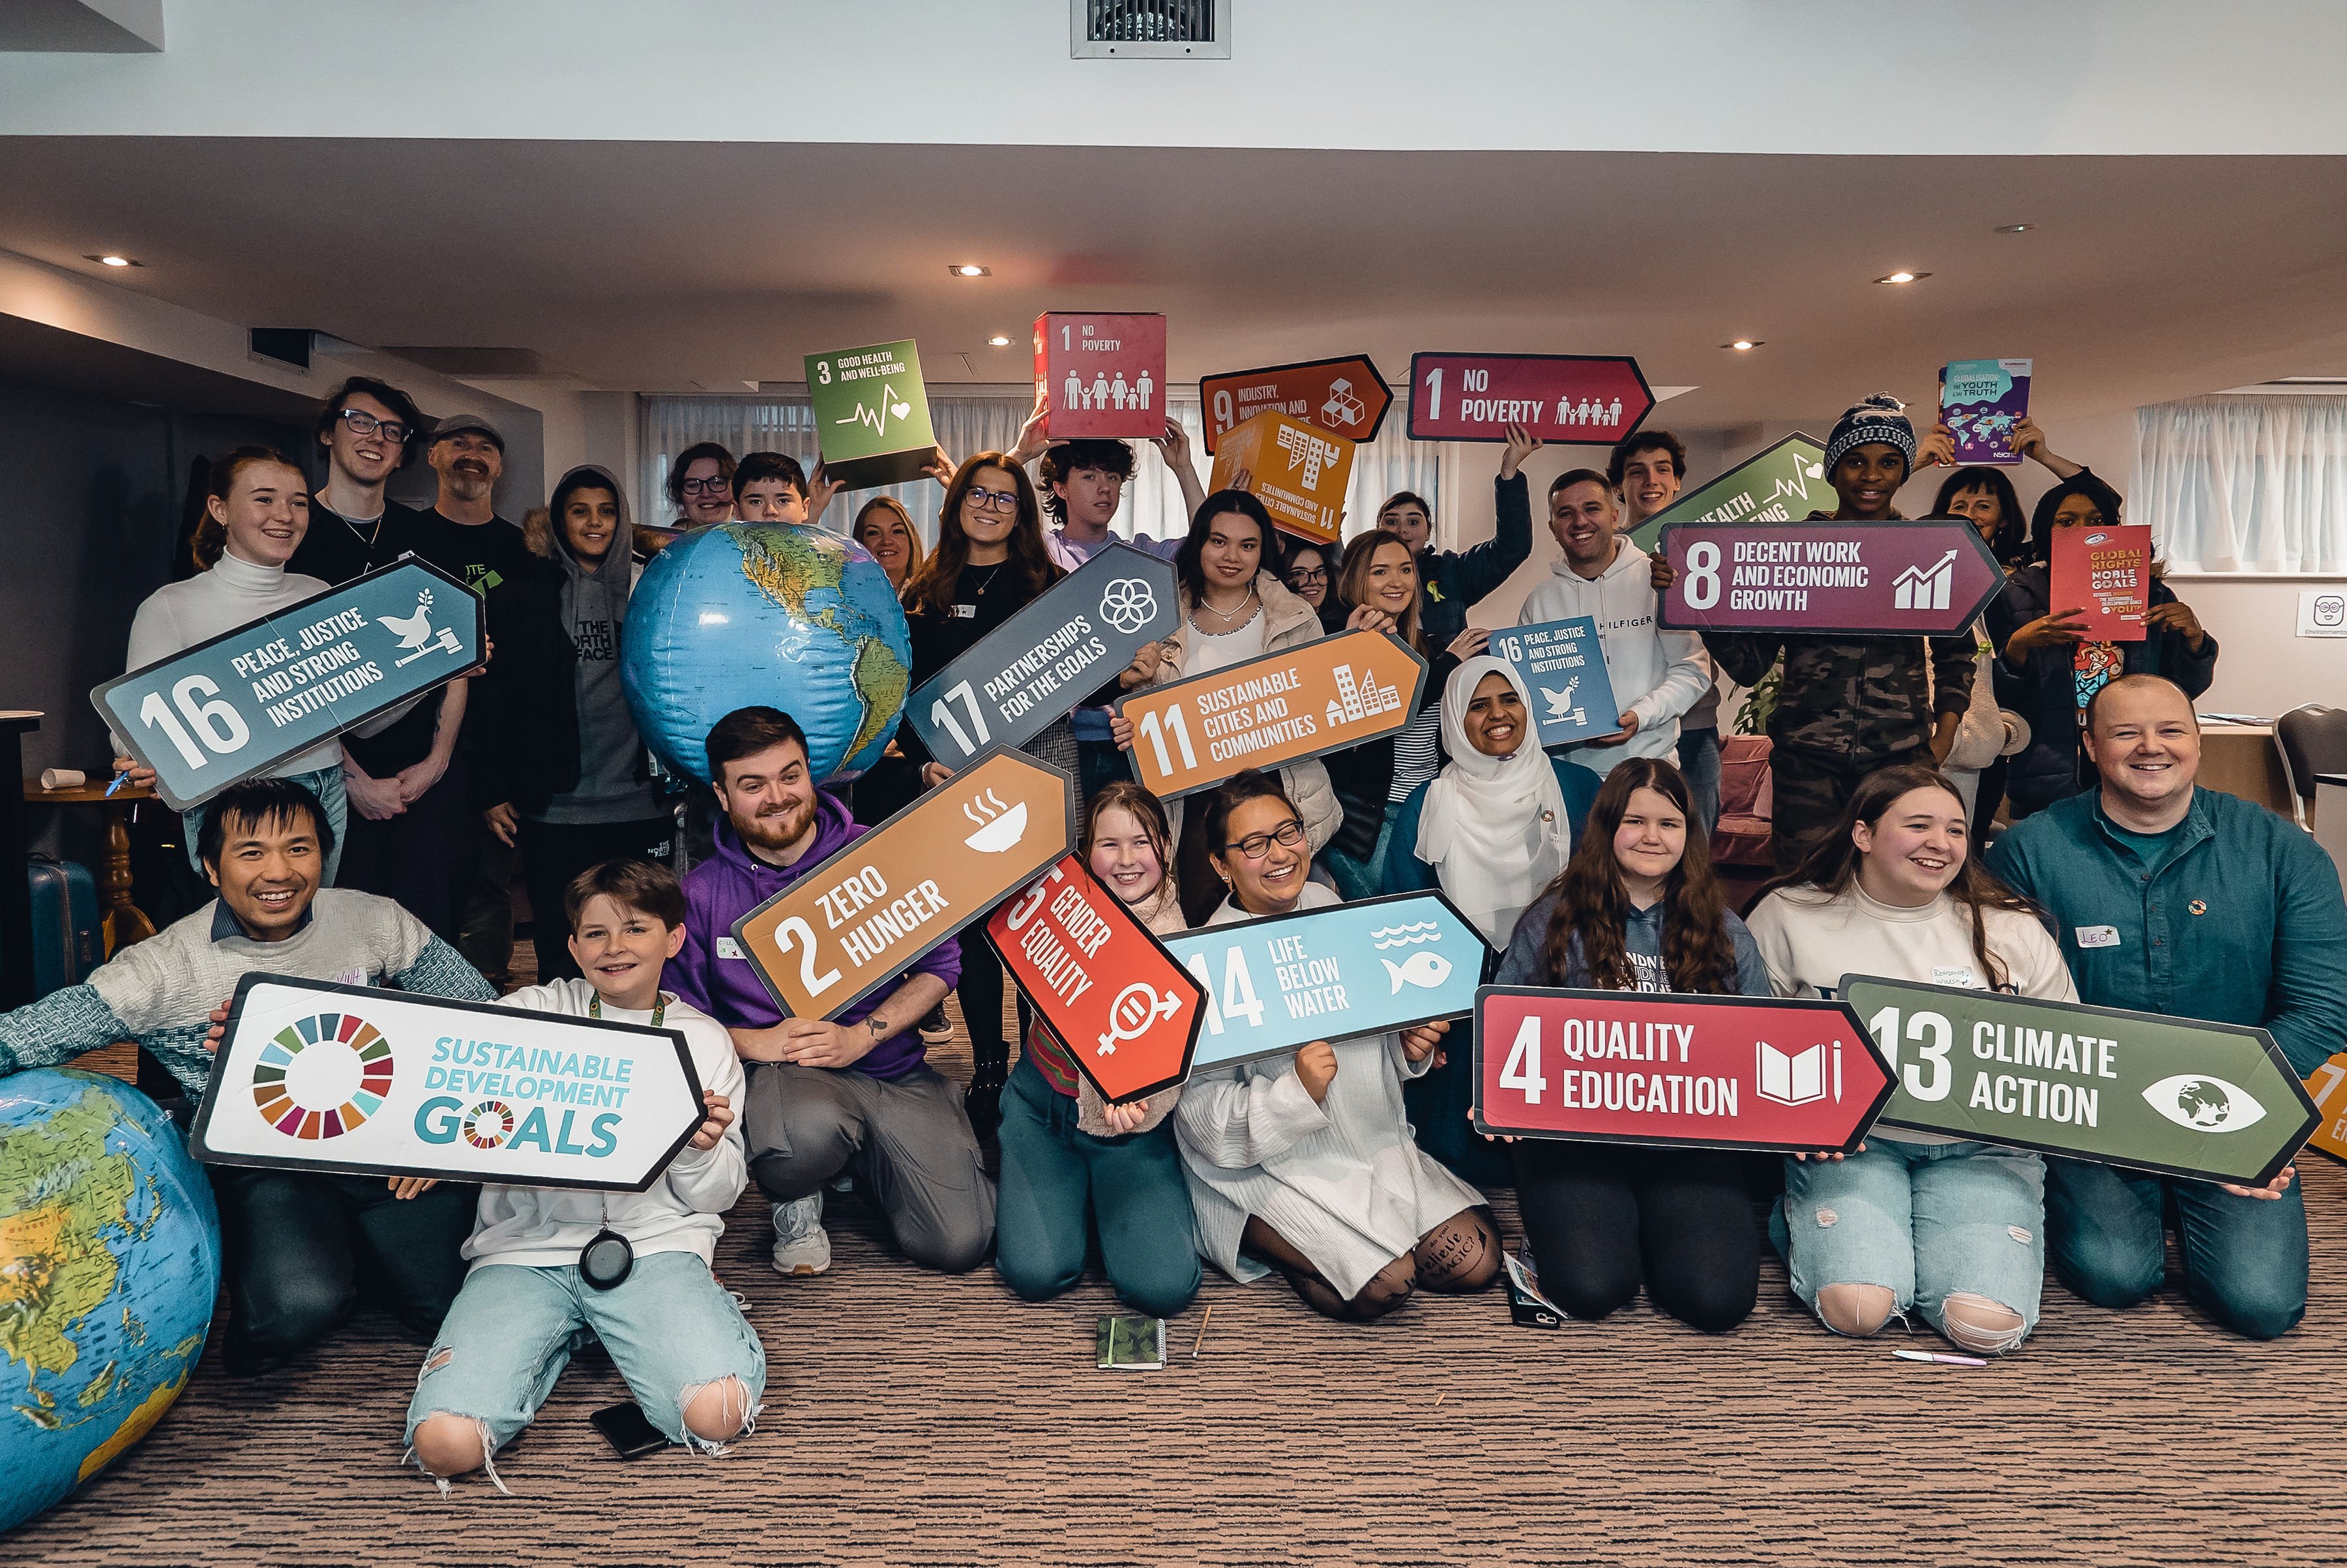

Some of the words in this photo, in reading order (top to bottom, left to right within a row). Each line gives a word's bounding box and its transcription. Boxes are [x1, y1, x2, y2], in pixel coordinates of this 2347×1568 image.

[1062, 325, 1070, 351] 1
[1082, 325, 1094, 336] NO
[1082, 340, 1121, 351] POVERTY
[818, 361, 831, 385] 3
[838, 357, 861, 368] GOOD
[861, 351, 893, 364] HEALTH
[841, 370, 857, 381] AND
[859, 362, 906, 378] WELL-BEING
[1239, 385, 1279, 402] INDUSTRY,
[1426, 368, 1443, 420] 1
[1463, 369, 1488, 392] NO
[1214, 390, 1233, 435] 9
[1289, 400, 1306, 415] AND
[1461, 399, 1544, 423] POVERTY
[1262, 482, 1305, 507] COMMUNITIES
[1275, 500, 1316, 524] SUSTAINABLE
[1305, 499, 1319, 512] AND
[1320, 507, 1334, 530] 11
[1734, 542, 1802, 563] DECENT
[1806, 542, 1861, 563] WORK
[2090, 548, 2142, 561] GLOBAL
[1683, 541, 1721, 610] 8
[1732, 566, 1769, 586] AND
[1773, 566, 1869, 587] ECONOMIC
[2092, 569, 2135, 580] NOBLE
[2092, 578, 2138, 589] GOALS
[1730, 589, 1808, 611] GROWTH
[578, 620, 610, 634] THE
[1524, 632, 1553, 645] PEACE,
[1554, 626, 1586, 642] JUSTICE
[1599, 615, 1653, 630] HILFIGER
[230, 638, 301, 679] PEACE,
[299, 607, 368, 649] JUSTICE
[574, 634, 612, 649] ORTH
[574, 648, 615, 662] FACE
[982, 615, 1093, 703] PARTNERSHIPS
[1498, 636, 1523, 663] 16
[1528, 645, 1545, 660] AND
[1546, 642, 1578, 657] STRONG
[250, 669, 293, 703] AND
[291, 640, 361, 683] STRONG
[997, 691, 1034, 724] FOR
[1026, 667, 1063, 703] THE
[1054, 636, 1107, 684] GOALS
[1531, 655, 1586, 674] INSTITUTIONS
[265, 661, 383, 728] INSTITUTIONS
[1196, 668, 1302, 716] SUSTAINABLE
[140, 674, 250, 770] 16
[930, 679, 992, 757] 17
[1203, 705, 1254, 739] CITIES
[1254, 696, 1289, 728] AND
[1140, 703, 1198, 778] 11
[1209, 714, 1317, 763] COMMUNITIES
[814, 865, 889, 931] ZERO
[1007, 865, 1064, 932] 5
[838, 878, 950, 968] HUNGER
[1050, 884, 1112, 961] GENDER
[2081, 930, 2108, 944] LEO
[774, 915, 843, 999] 2
[1019, 917, 1093, 1008] EQUALITY
[1267, 934, 1309, 966] LIFE
[1185, 945, 1265, 1037] 14
[1275, 956, 1341, 993] BELOW
[1282, 984, 1351, 1020] WATER
[1563, 1018, 1695, 1063] QUALITY
[1868, 1005, 1954, 1102] 13
[1972, 1020, 2118, 1079] CLIMATE
[431, 1037, 634, 1084] SUSTAINABLE
[1499, 1015, 1547, 1105] 4
[424, 1066, 630, 1109] DEVELOPMENT
[1563, 1069, 1738, 1117] EDUCATION
[1969, 1071, 2098, 1128] ACTION
[2314, 1063, 2347, 1108] 7
[413, 1095, 623, 1159] GOALS
[1439, 1225, 1449, 1239] you
